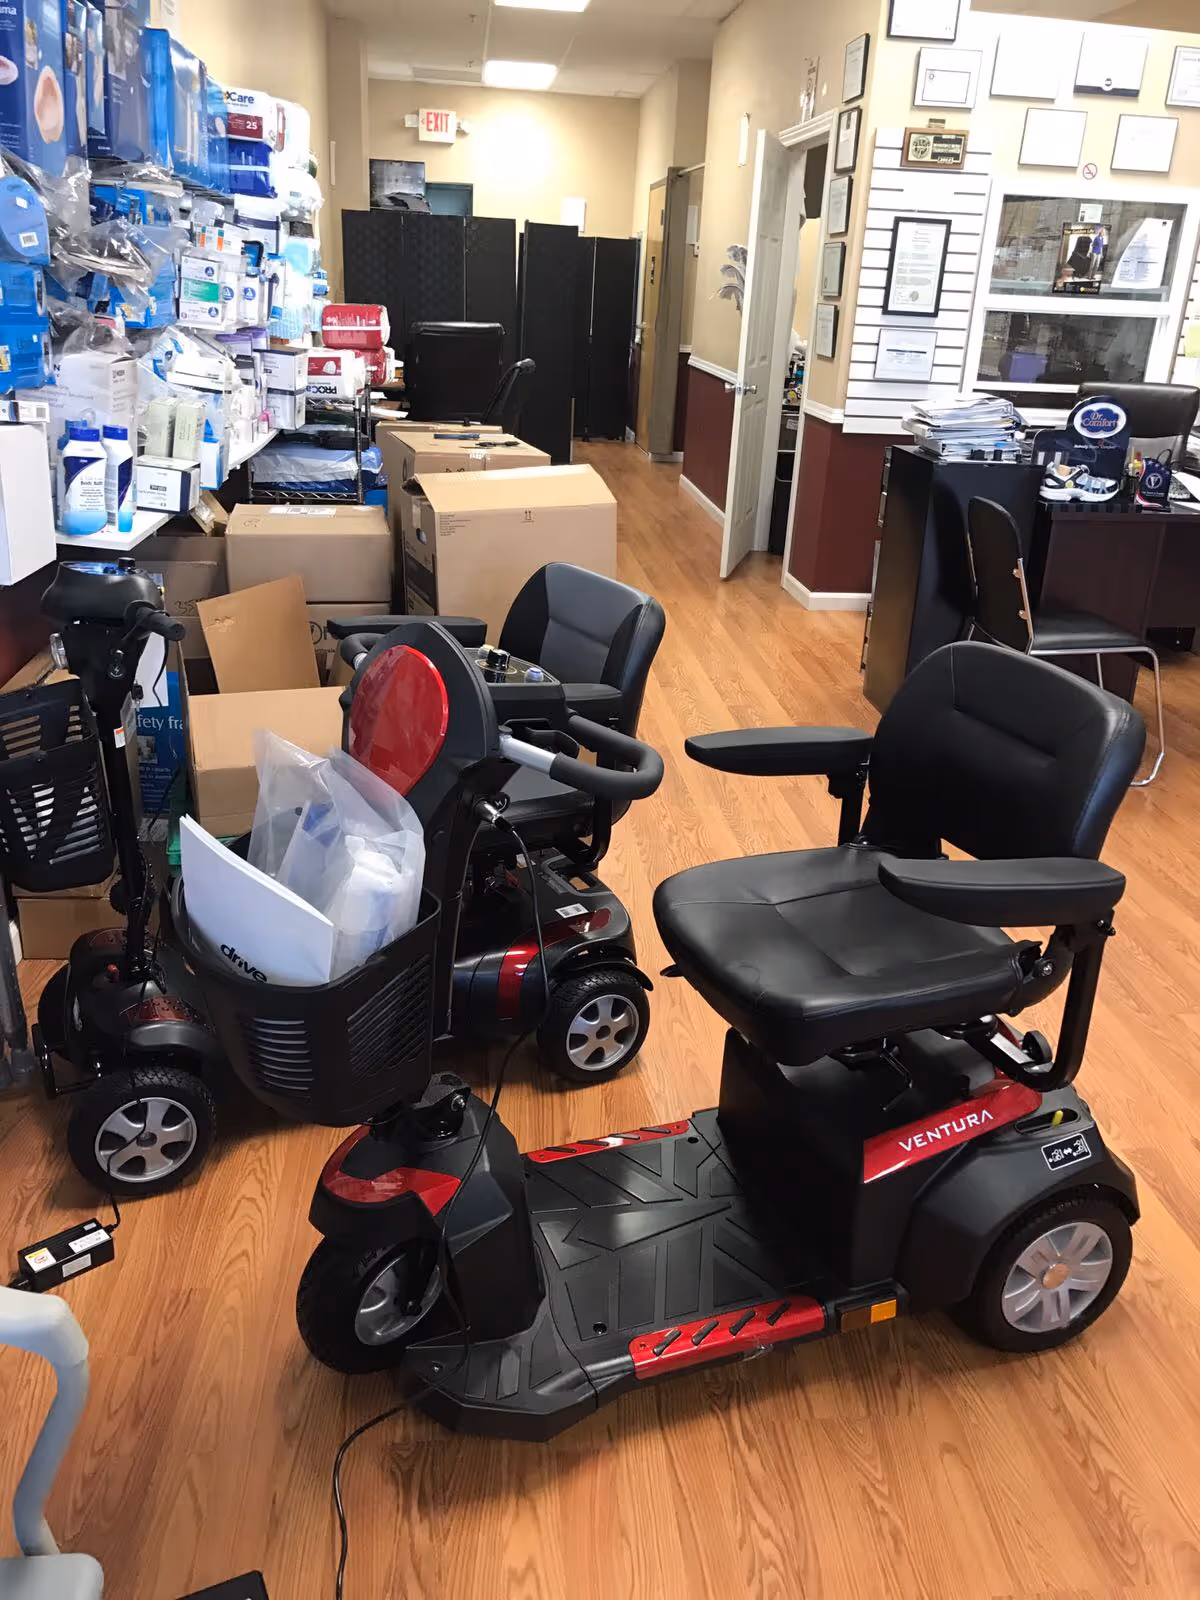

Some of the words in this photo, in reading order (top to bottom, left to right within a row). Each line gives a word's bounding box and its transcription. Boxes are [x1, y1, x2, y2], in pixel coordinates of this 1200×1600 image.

[246, 121, 258, 130] 25
[426, 111, 449, 132] EXIT
[305, 385, 337, 394] PROCa
[1082, 418, 1117, 427] Comfort
[1090, 412, 1104, 421] Dr.
[137, 714, 164, 730] fety
[220, 943, 267, 984] drive
[899, 1109, 994, 1152] VENTURA
